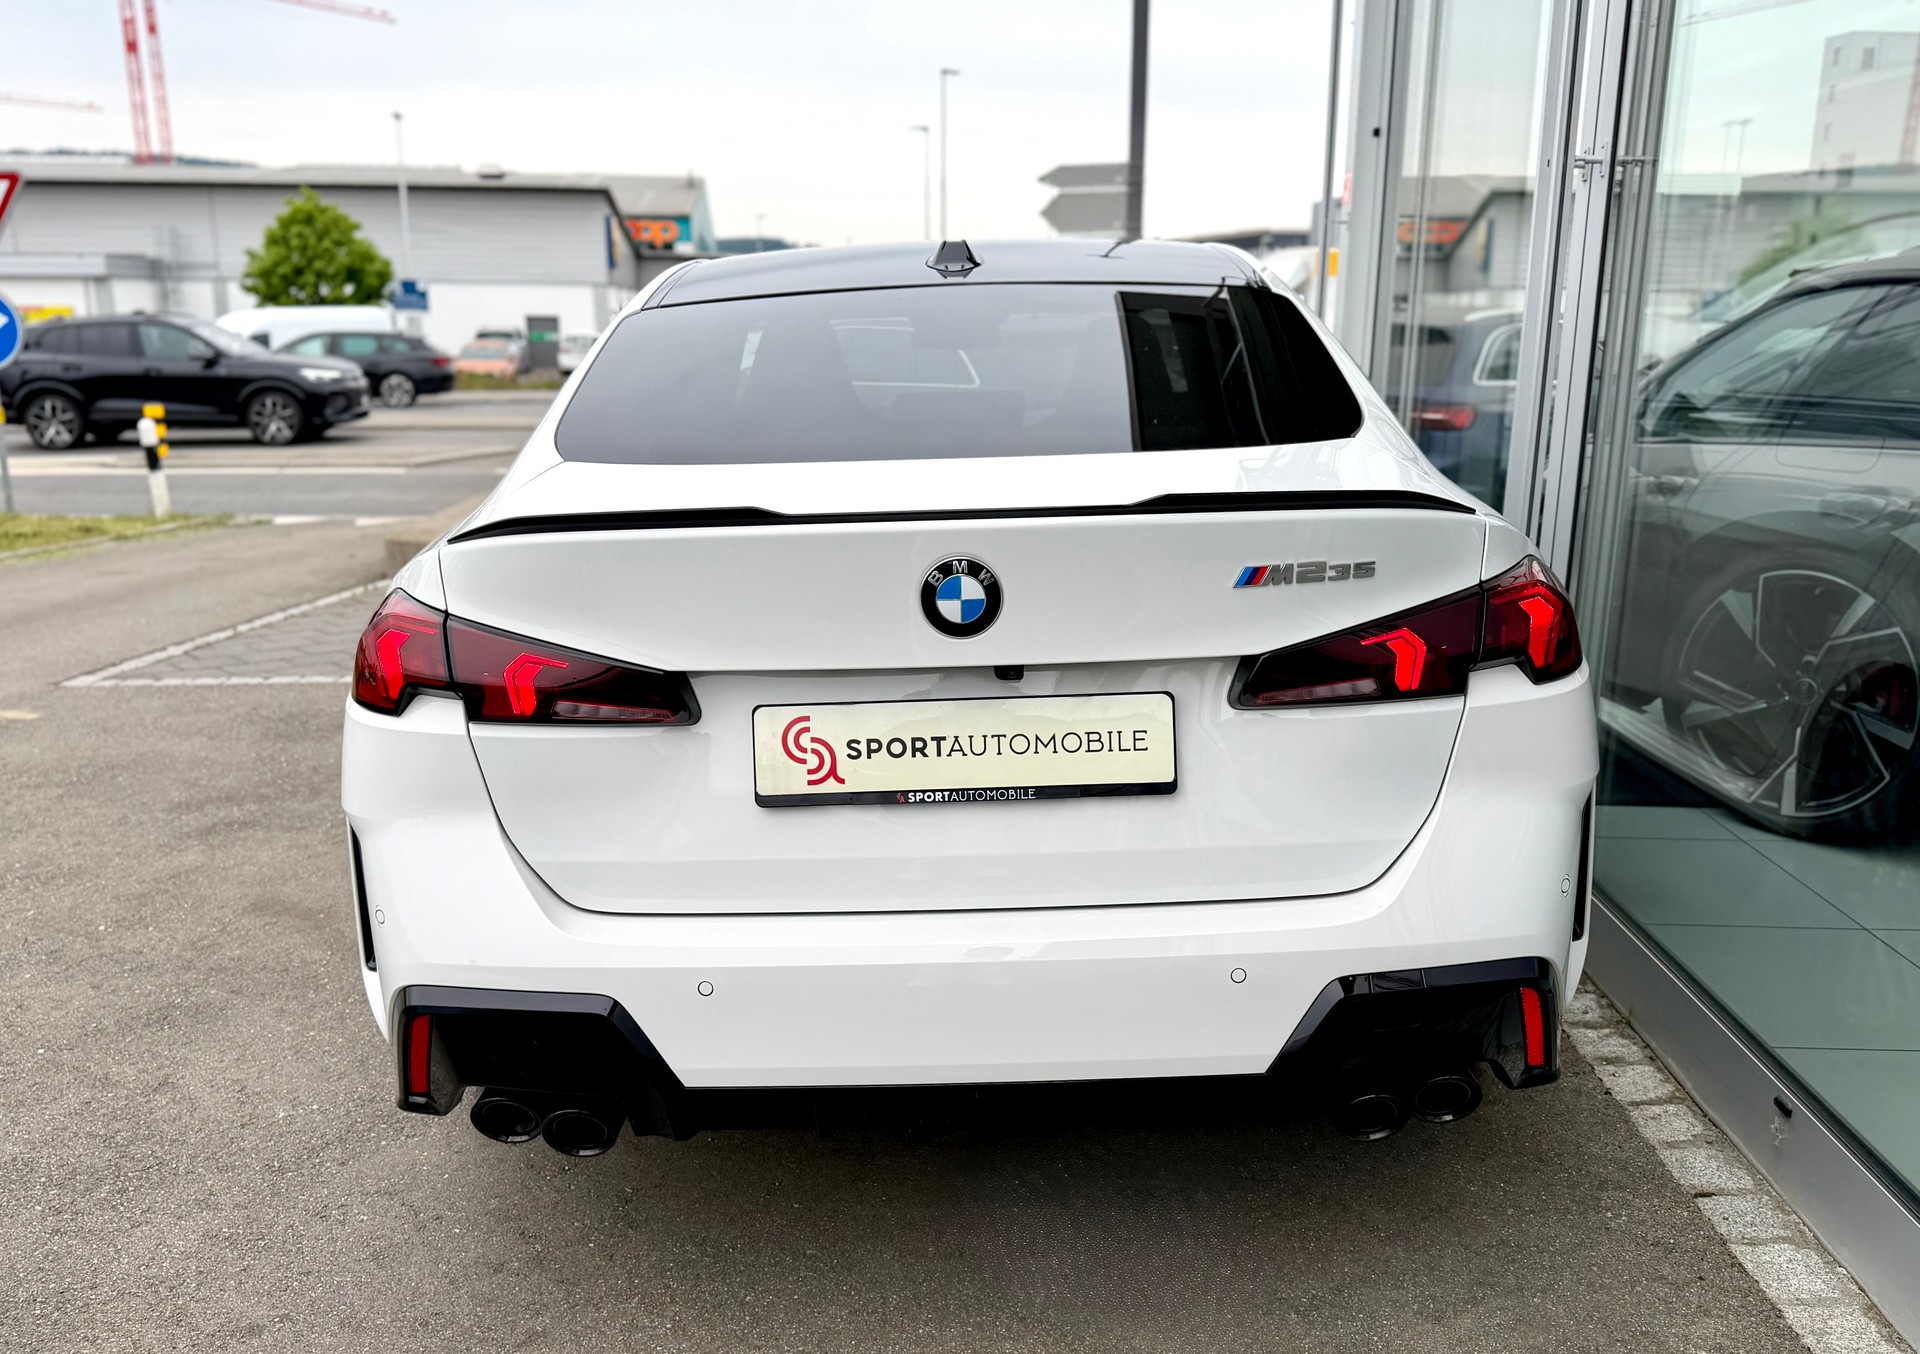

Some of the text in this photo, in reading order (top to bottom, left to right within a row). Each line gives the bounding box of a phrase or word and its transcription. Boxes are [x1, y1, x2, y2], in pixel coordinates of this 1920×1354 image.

[927, 560, 995, 588] BMW
[1258, 560, 1376, 587] M235
[846, 730, 1149, 760] SPORTAUTOMOBILE
[908, 788, 1036, 803] SPORTAUTOMOBILE
